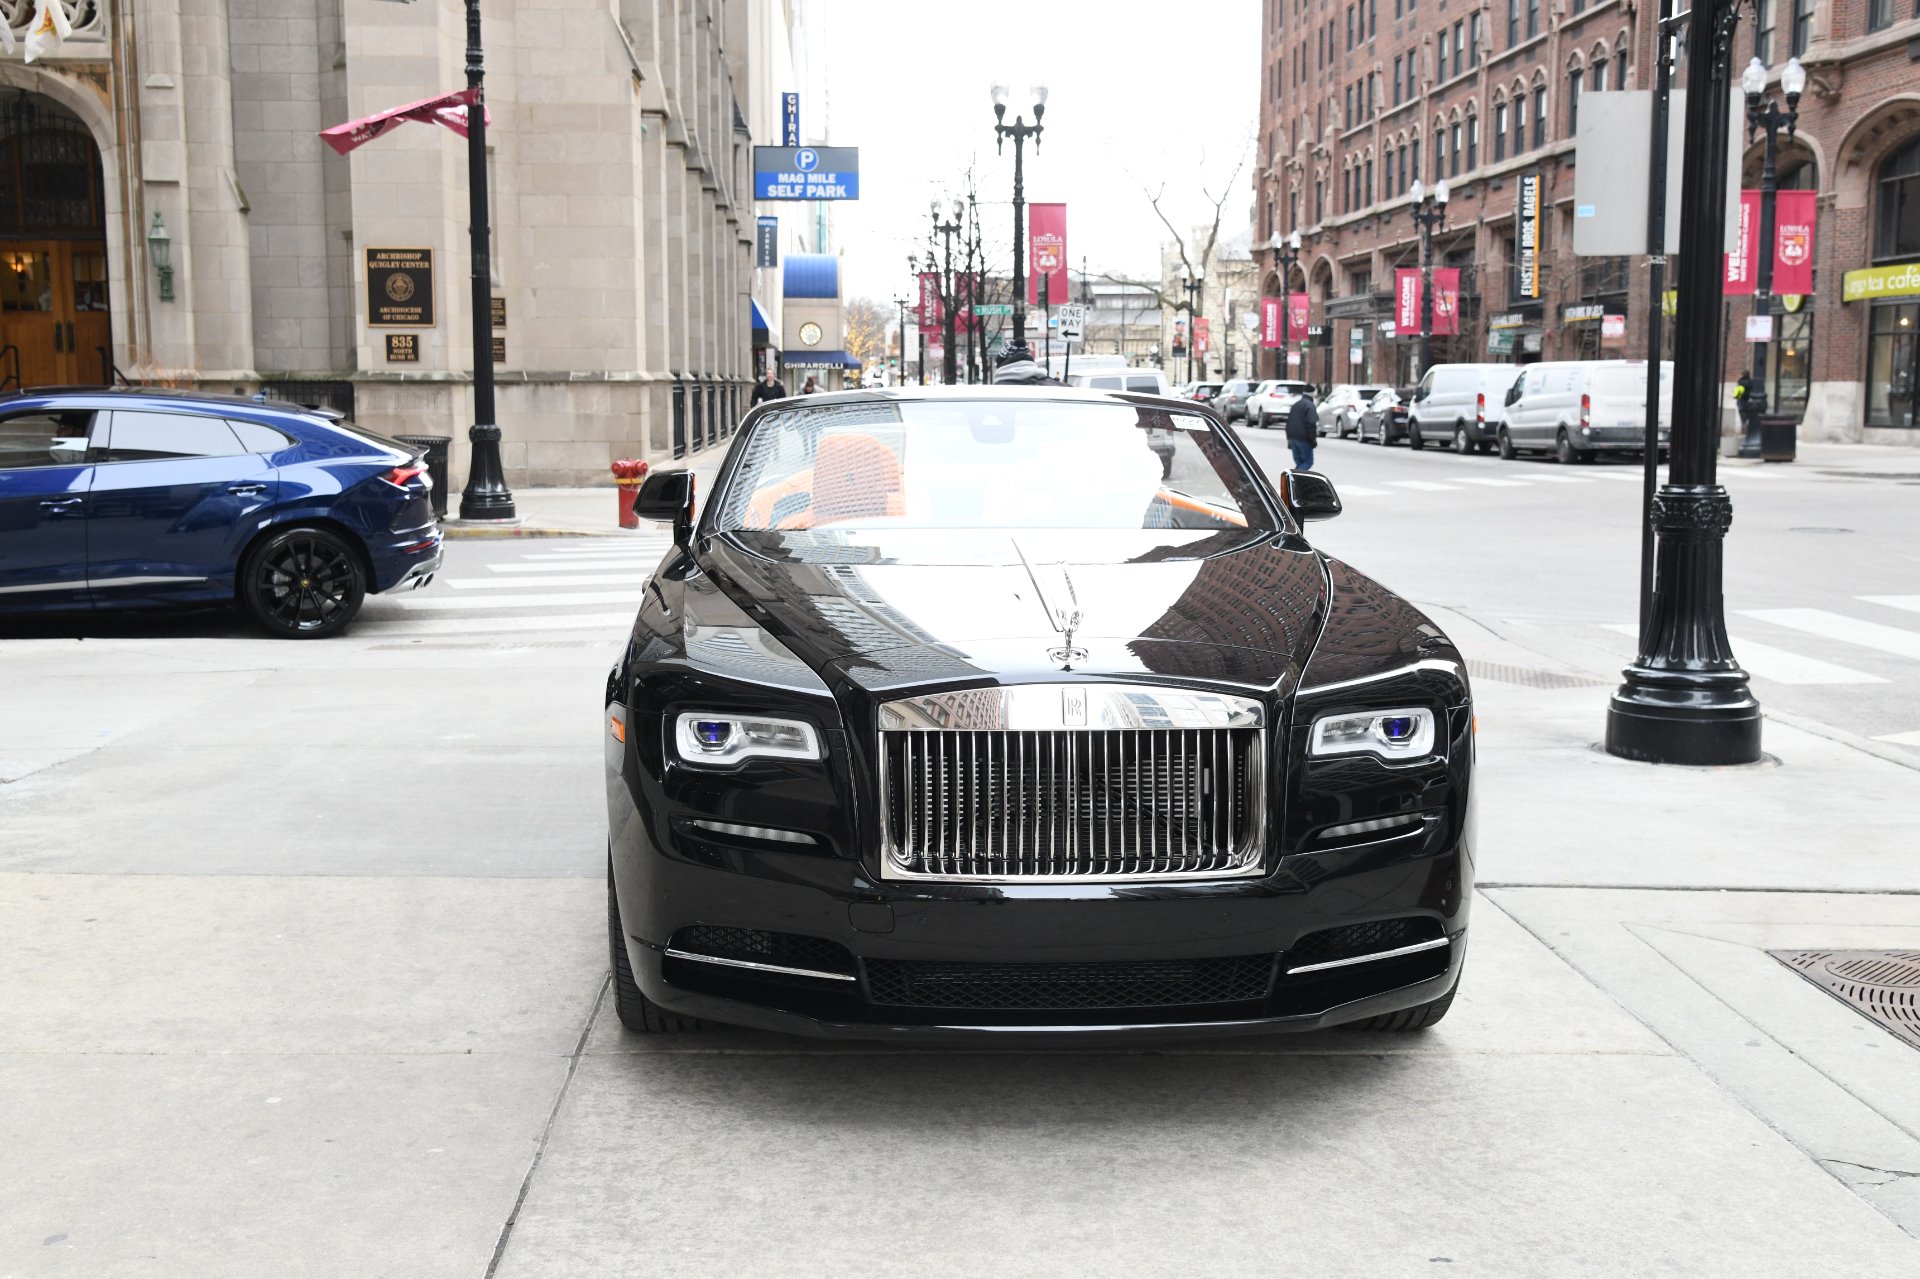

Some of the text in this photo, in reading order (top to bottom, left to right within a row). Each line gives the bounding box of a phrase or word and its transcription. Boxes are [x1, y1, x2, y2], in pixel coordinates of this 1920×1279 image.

[800, 151, 815, 169] P
[778, 173, 836, 184] MAG MILE
[767, 184, 847, 198] SELF PARK
[1523, 176, 1536, 217] BAGELS
[376, 252, 422, 260] ARCHBISHOP
[368, 261, 400, 269] QUIGLEY
[1520, 249, 1534, 296] EINSTEIN
[1887, 265, 1920, 289] café
[1401, 276, 1410, 327] WELCOME
[982, 305, 1002, 315] RUSH
[1061, 308, 1081, 318] ONE
[1060, 319, 1081, 327] WAY
[391, 336, 413, 348] 835
